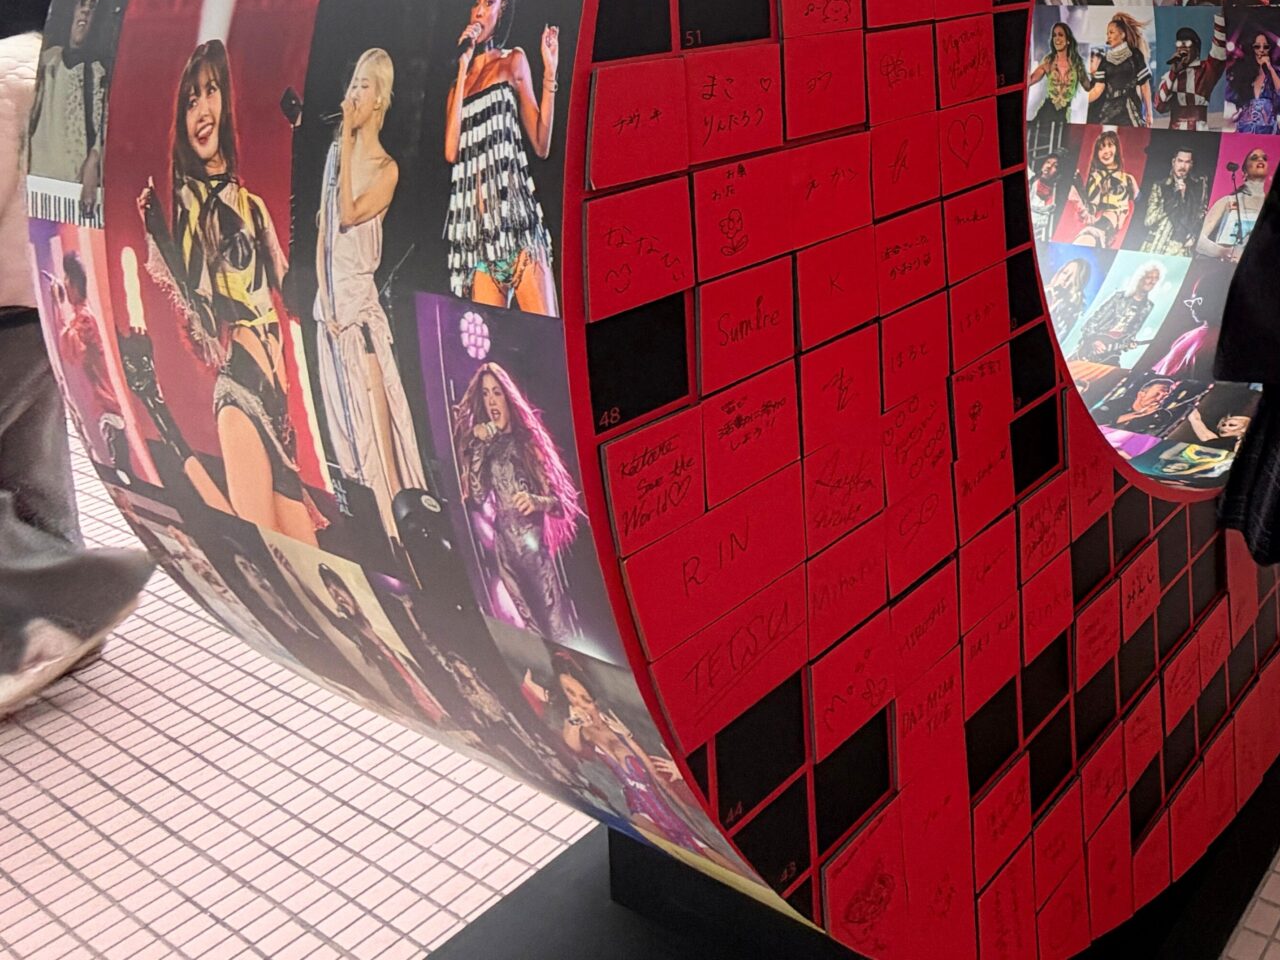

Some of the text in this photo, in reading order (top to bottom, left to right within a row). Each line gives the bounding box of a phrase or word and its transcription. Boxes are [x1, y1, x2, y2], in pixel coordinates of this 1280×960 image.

[686, 28, 702, 46] 51
[701, 73, 735, 101] まこ
[718, 294, 781, 347] Sumire
[600, 406, 621, 428] 48
[681, 514, 750, 599] RIN
